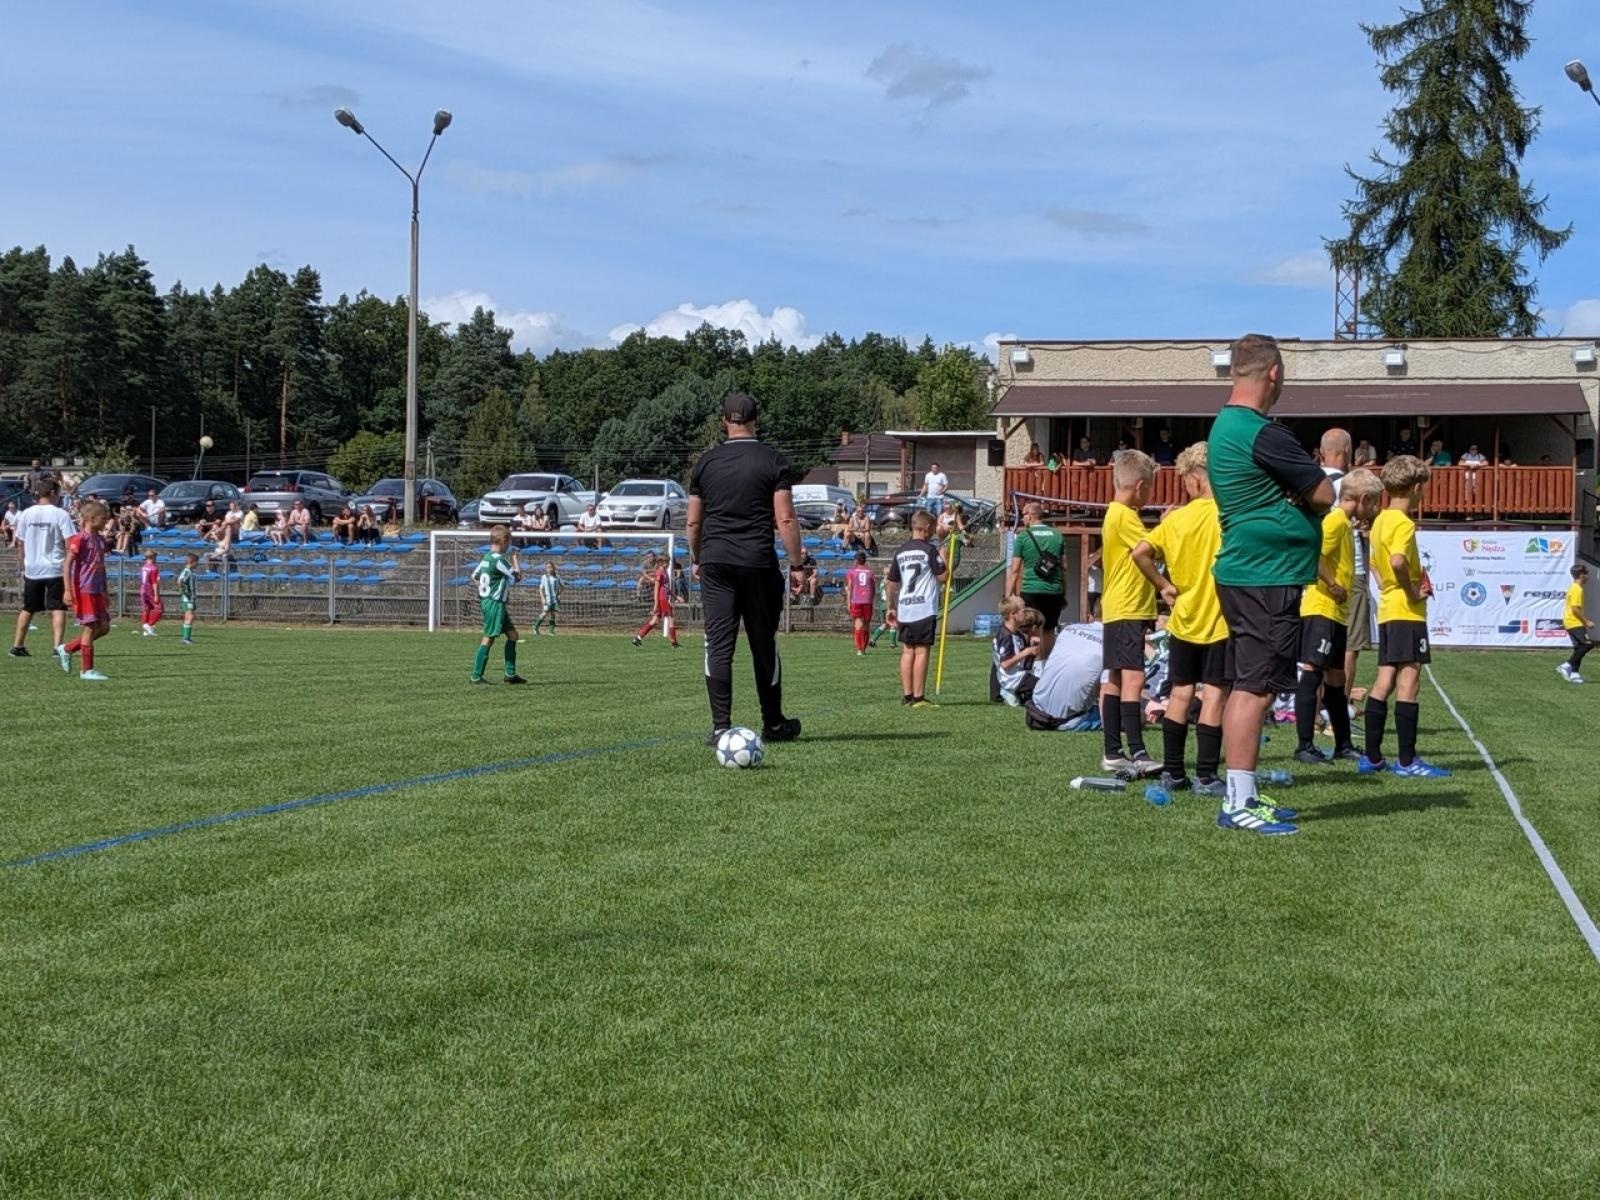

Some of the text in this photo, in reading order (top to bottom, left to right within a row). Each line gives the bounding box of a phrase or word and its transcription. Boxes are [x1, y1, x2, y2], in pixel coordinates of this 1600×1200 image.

[479, 573, 490, 597] 8
[860, 571, 866, 585] 9
[1419, 638, 1427, 653] 3
